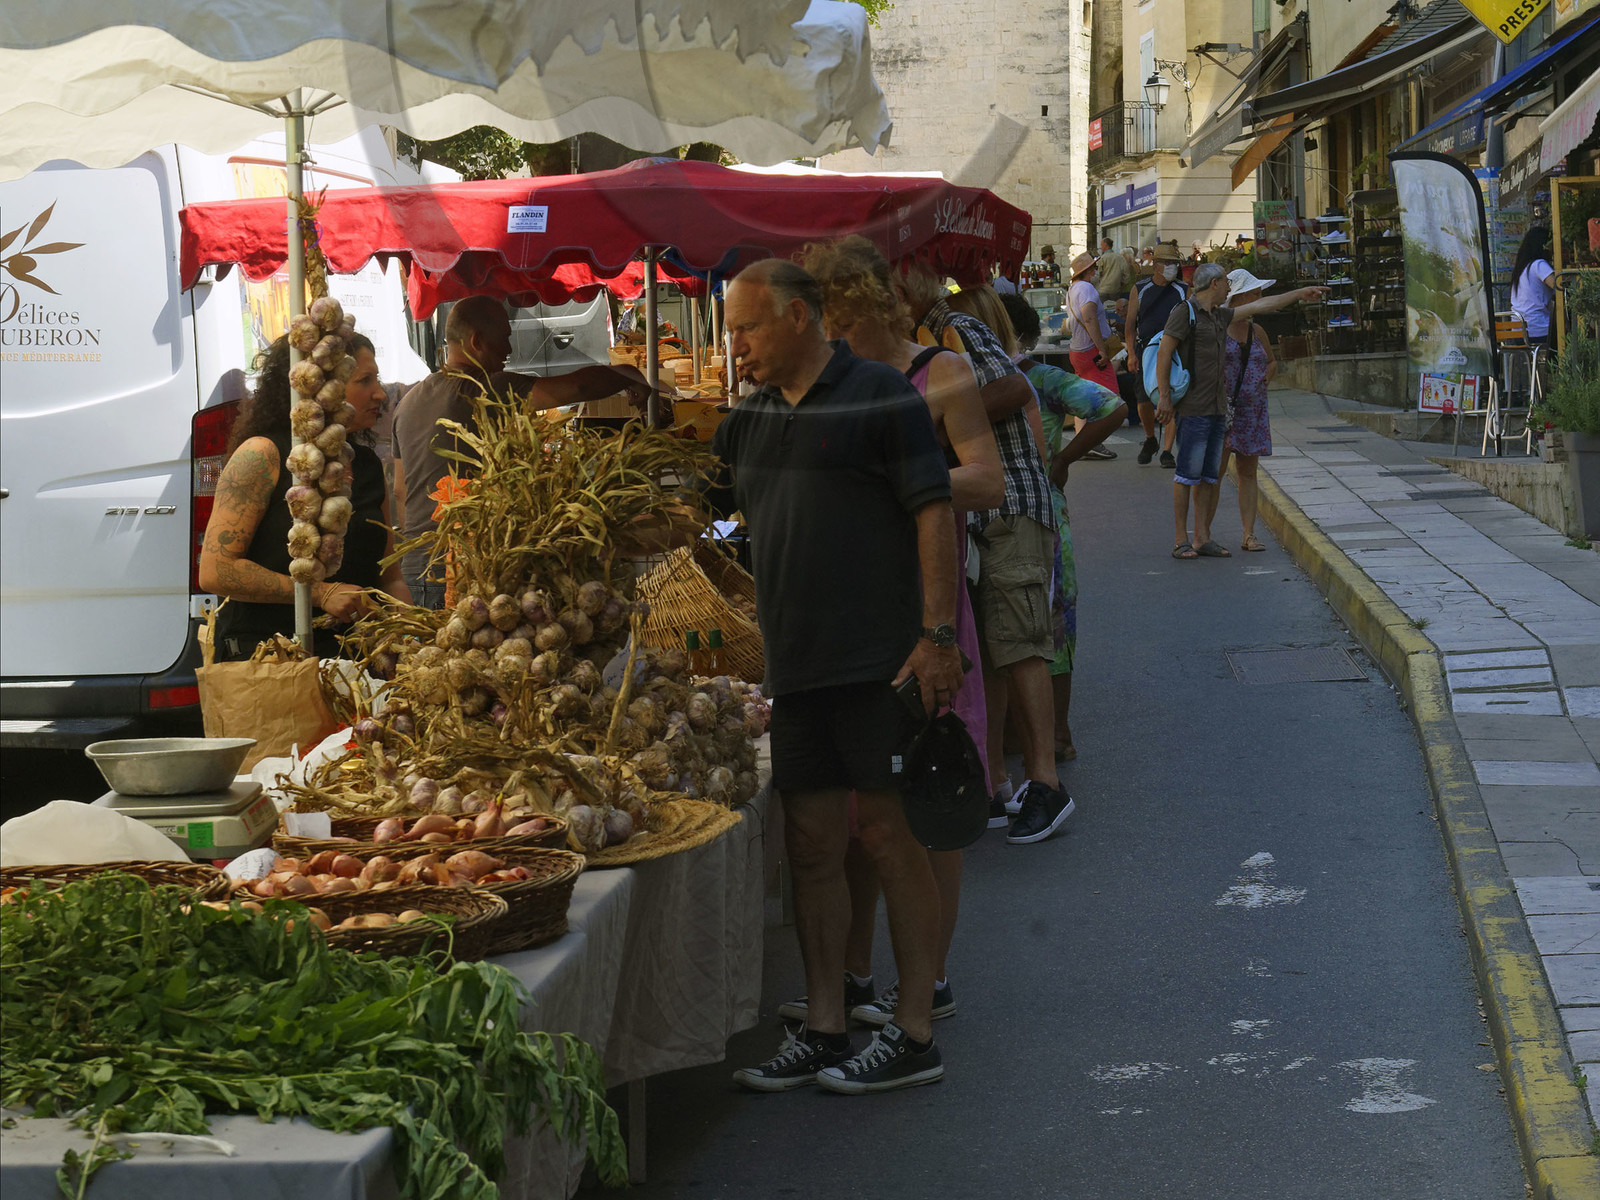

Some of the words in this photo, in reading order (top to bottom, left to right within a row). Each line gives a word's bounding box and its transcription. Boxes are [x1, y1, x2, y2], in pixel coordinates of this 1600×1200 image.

[22, 350, 102, 362] MÉDITERRANÉE
[104, 505, 140, 516] 213
[144, 504, 177, 515] CDI
